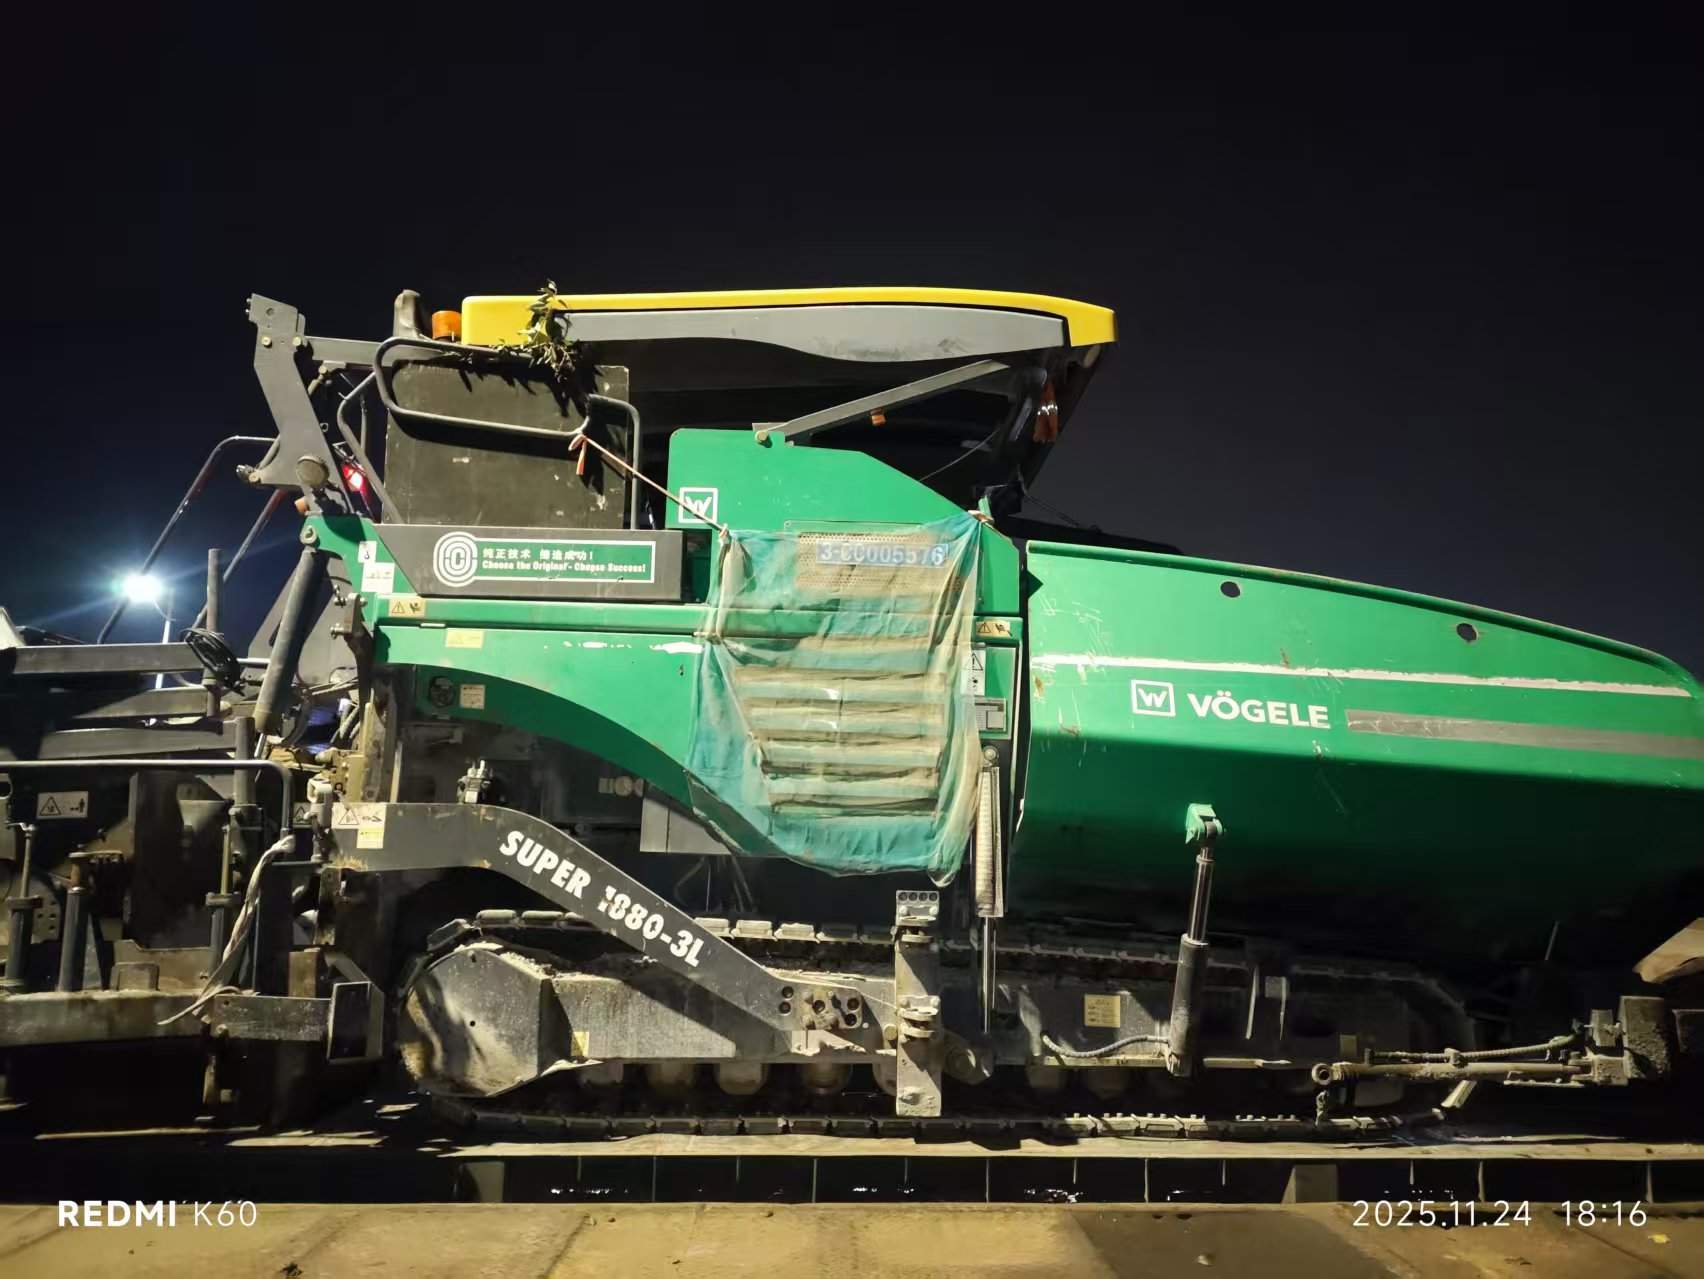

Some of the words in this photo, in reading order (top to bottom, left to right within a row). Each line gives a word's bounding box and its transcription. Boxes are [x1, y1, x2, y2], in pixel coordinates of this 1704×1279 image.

[482, 560, 514, 571] Choose
[516, 561, 531, 571] the
[574, 562, 605, 573] Choose
[607, 563, 646, 574] Success!
[1187, 690, 1331, 729] VÖGELE
[499, 830, 592, 899] SUPER
[597, 885, 705, 968] 1880-3L
